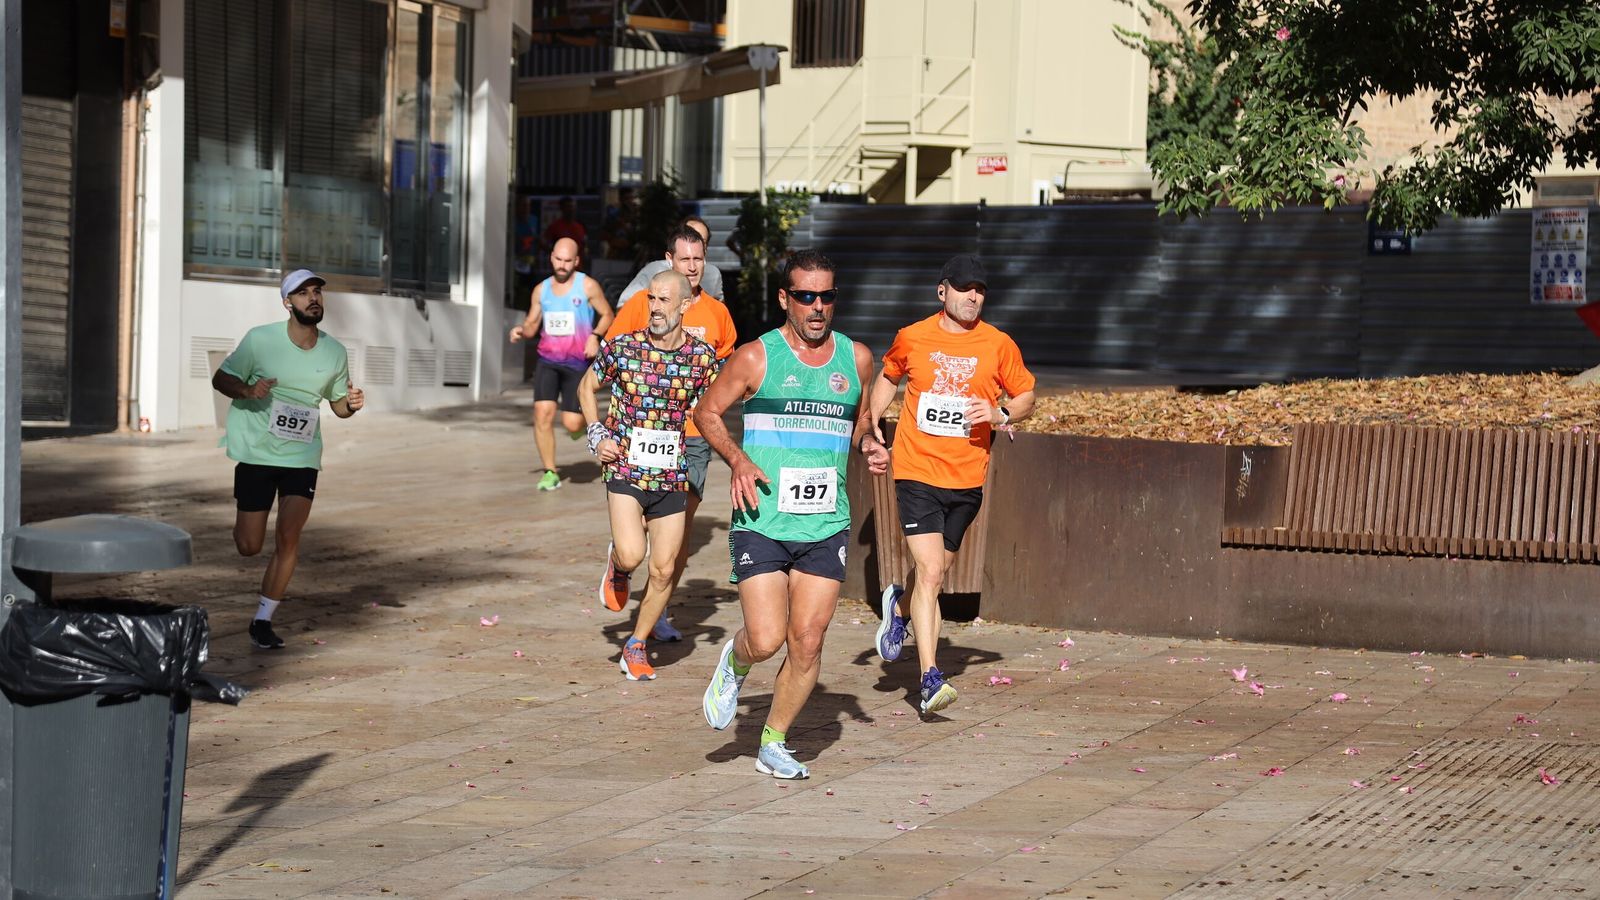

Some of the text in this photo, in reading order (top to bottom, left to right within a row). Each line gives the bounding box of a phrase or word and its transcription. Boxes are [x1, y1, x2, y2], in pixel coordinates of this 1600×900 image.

[784, 400, 844, 417] ATLETISMO
[926, 408, 964, 425] 622
[276, 414, 309, 431] 897
[772, 416, 848, 434] TORREMOLINOS
[638, 441, 675, 455] 1012
[789, 484, 828, 500] 197
